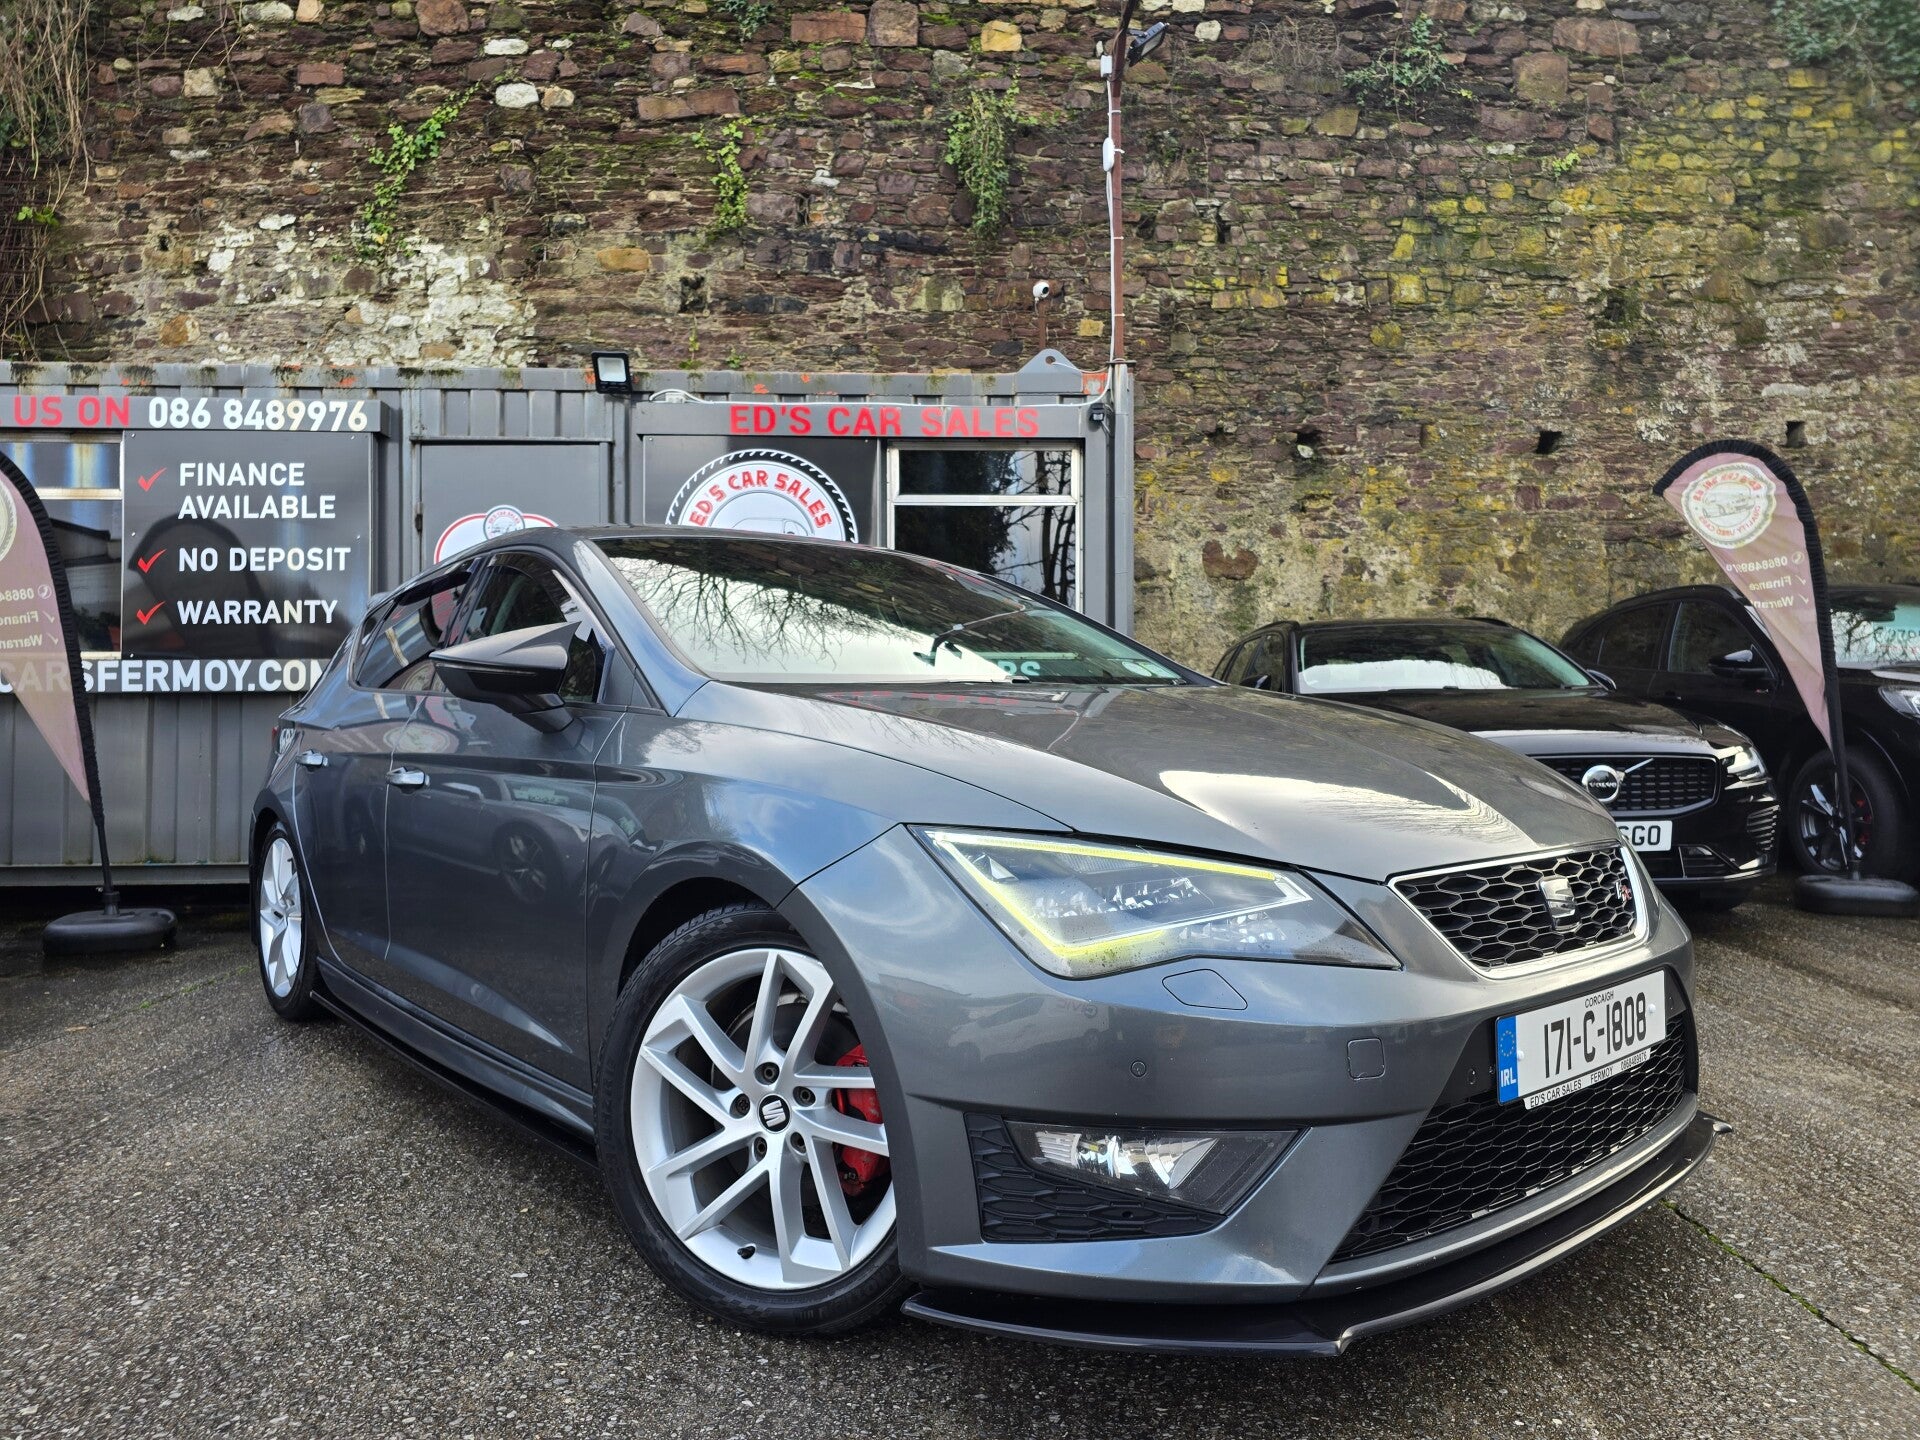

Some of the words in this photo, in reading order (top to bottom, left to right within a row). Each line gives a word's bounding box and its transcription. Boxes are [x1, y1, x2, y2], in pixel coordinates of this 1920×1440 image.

[14, 395, 63, 427] US
[77, 395, 130, 427] ON
[149, 397, 211, 429] 086
[223, 398, 368, 431] 8489976
[729, 405, 812, 435] ED'S
[827, 406, 903, 436] CAR
[920, 406, 1039, 437] SALES
[179, 462, 305, 486] FINANCE
[177, 495, 336, 519] AVAILABLE
[689, 484, 727, 526] ED'S
[728, 470, 769, 491] CAR
[774, 473, 832, 528] SALES
[178, 547, 219, 572] NO
[229, 547, 351, 572] DEPOSIT
[176, 599, 338, 625] WARRANTY
[1584, 990, 1615, 1008] CORCAIGH
[1544, 991, 1647, 1079] 171-C-1808
[1500, 1067, 1517, 1088] IRL
[1530, 1094, 1546, 1108] ED'S
[1546, 1088, 1561, 1101] CAR
[1562, 1079, 1582, 1096] SALES
[1590, 1066, 1613, 1084] FERMOY
